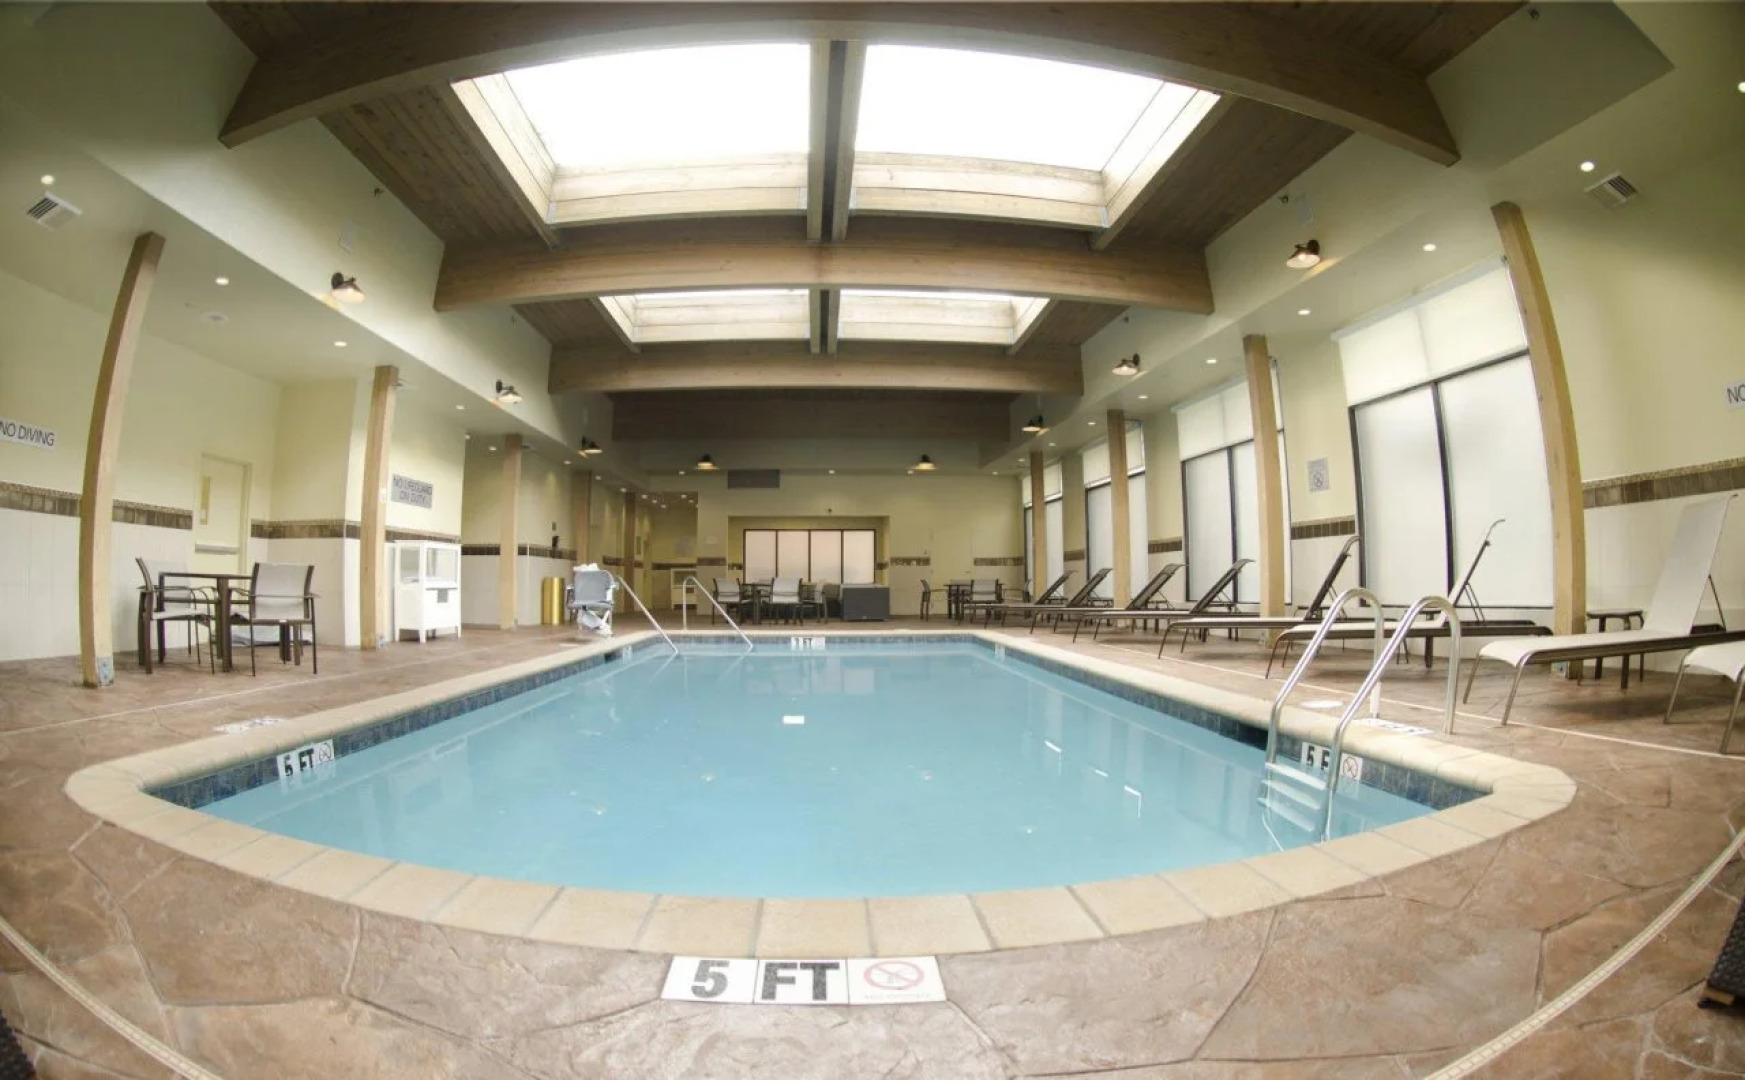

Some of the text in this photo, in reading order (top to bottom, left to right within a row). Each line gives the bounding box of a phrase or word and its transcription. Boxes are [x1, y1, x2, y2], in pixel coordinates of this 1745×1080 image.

[18, 425, 55, 447] DIVING
[299, 748, 314, 771] FT
[1306, 745, 1315, 766] 5
[691, 959, 840, 1000] 5 FT
